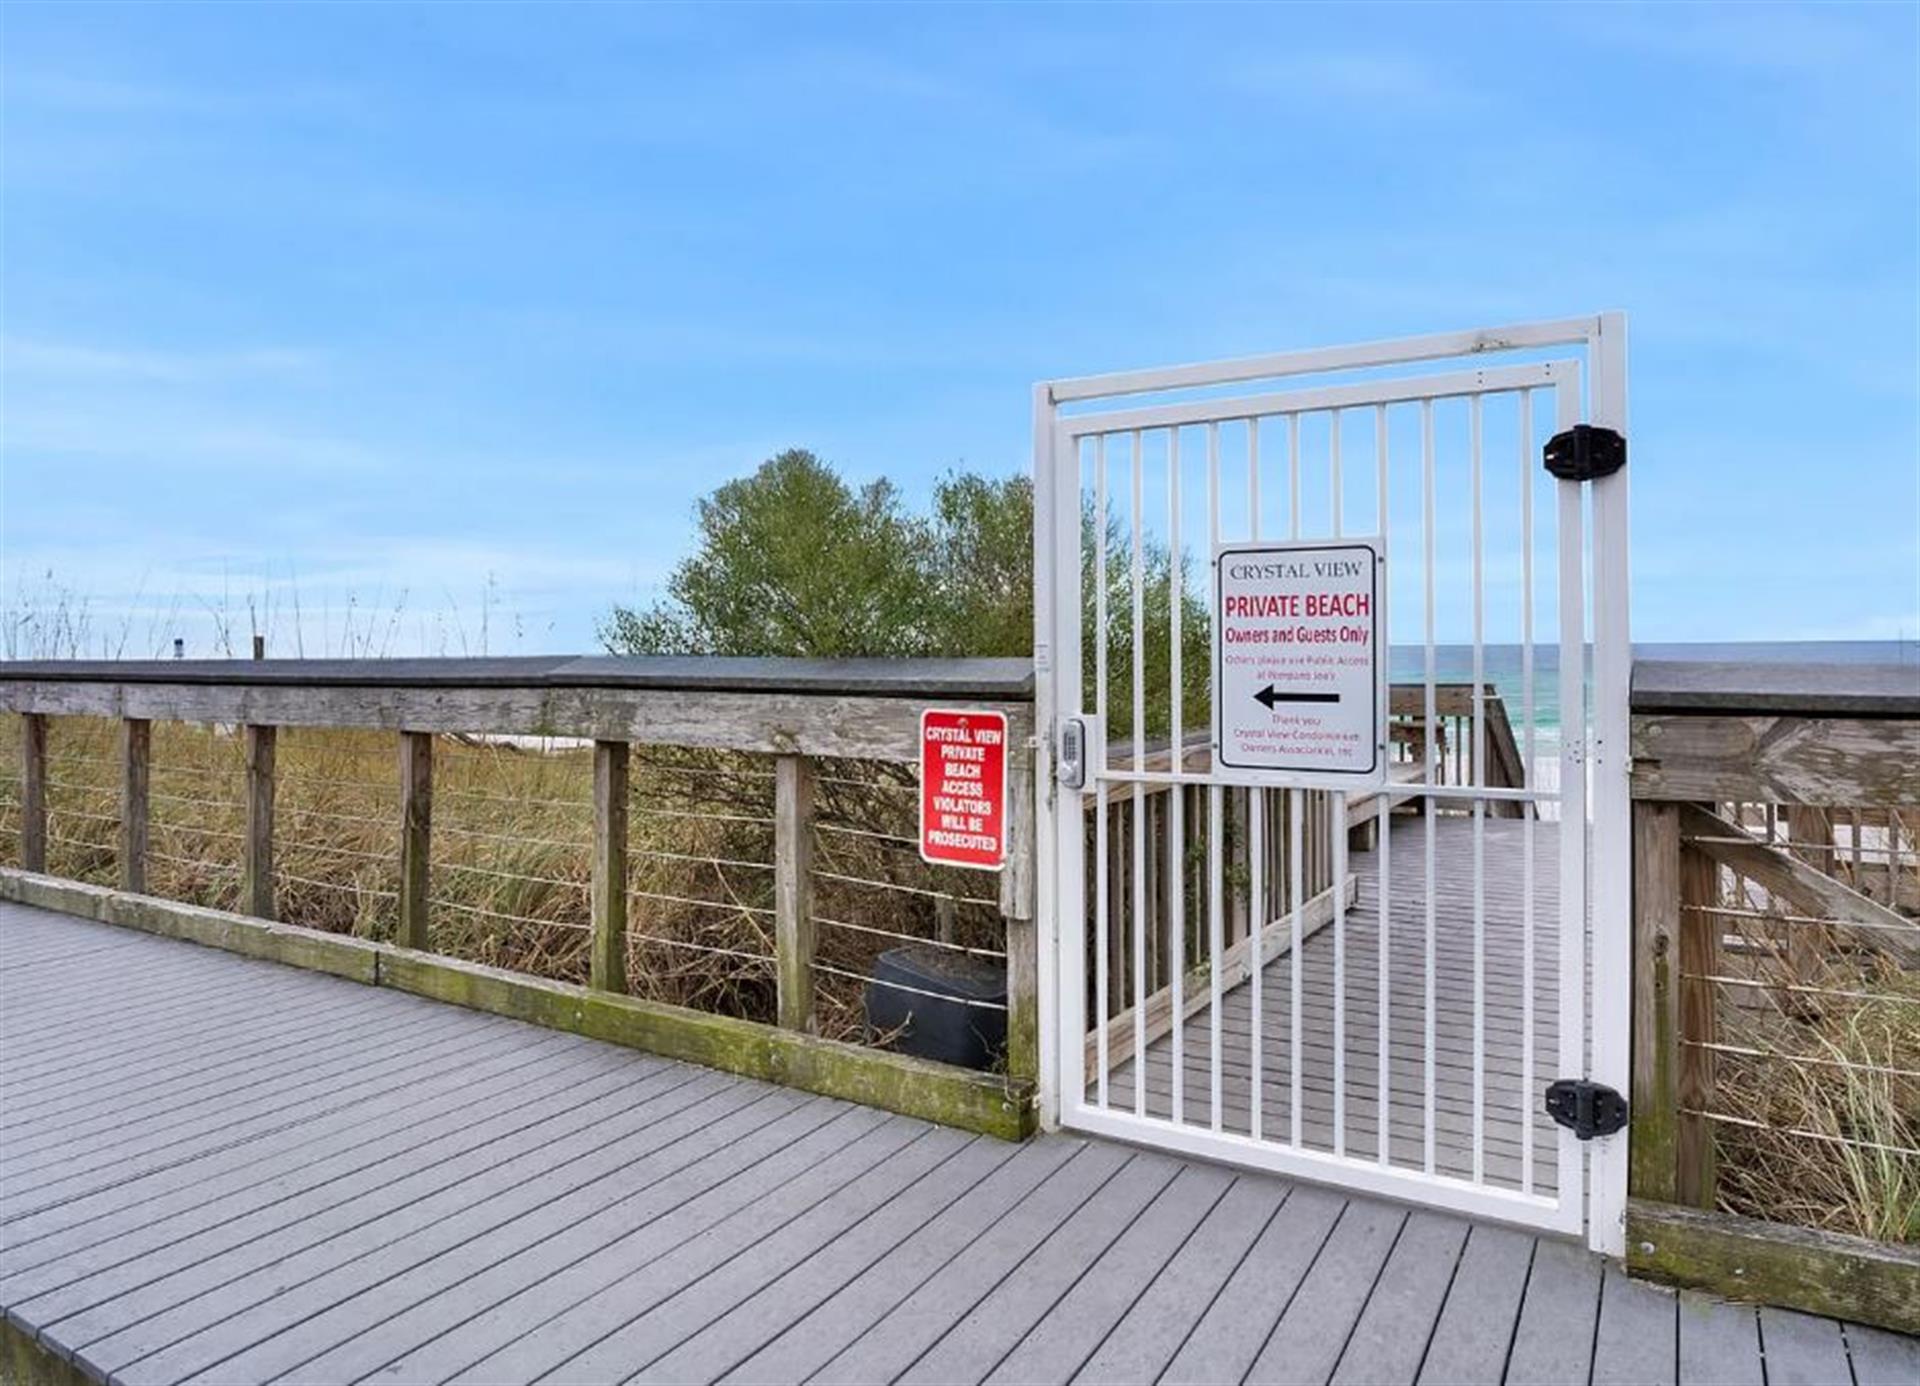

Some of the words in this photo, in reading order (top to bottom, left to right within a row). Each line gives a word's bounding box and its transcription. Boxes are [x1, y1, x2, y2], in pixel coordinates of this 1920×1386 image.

[1230, 563, 1310, 580] CRYSTAL
[1314, 561, 1362, 578] VIEW
[1226, 595, 1299, 618] PRIVATE
[1306, 594, 1369, 617] BEACH
[1225, 628, 1269, 644] Owners
[1272, 627, 1294, 643] and
[1297, 626, 1337, 644] Guests
[1340, 626, 1369, 646] Only
[1338, 654, 1368, 666] Access
[1272, 714, 1300, 724] Thank
[1302, 716, 1321, 726] you
[926, 726, 972, 743] CRYSTAL
[974, 729, 1002, 744] VIEW
[941, 745, 985, 760] PRIVATE
[945, 762, 981, 778] BEACH
[942, 780, 982, 797] ACCESS
[933, 796, 992, 814] VIOLATORS
[942, 814, 966, 830] WILL
[968, 816, 982, 832] BE
[928, 830, 997, 852] PROSECUTED
